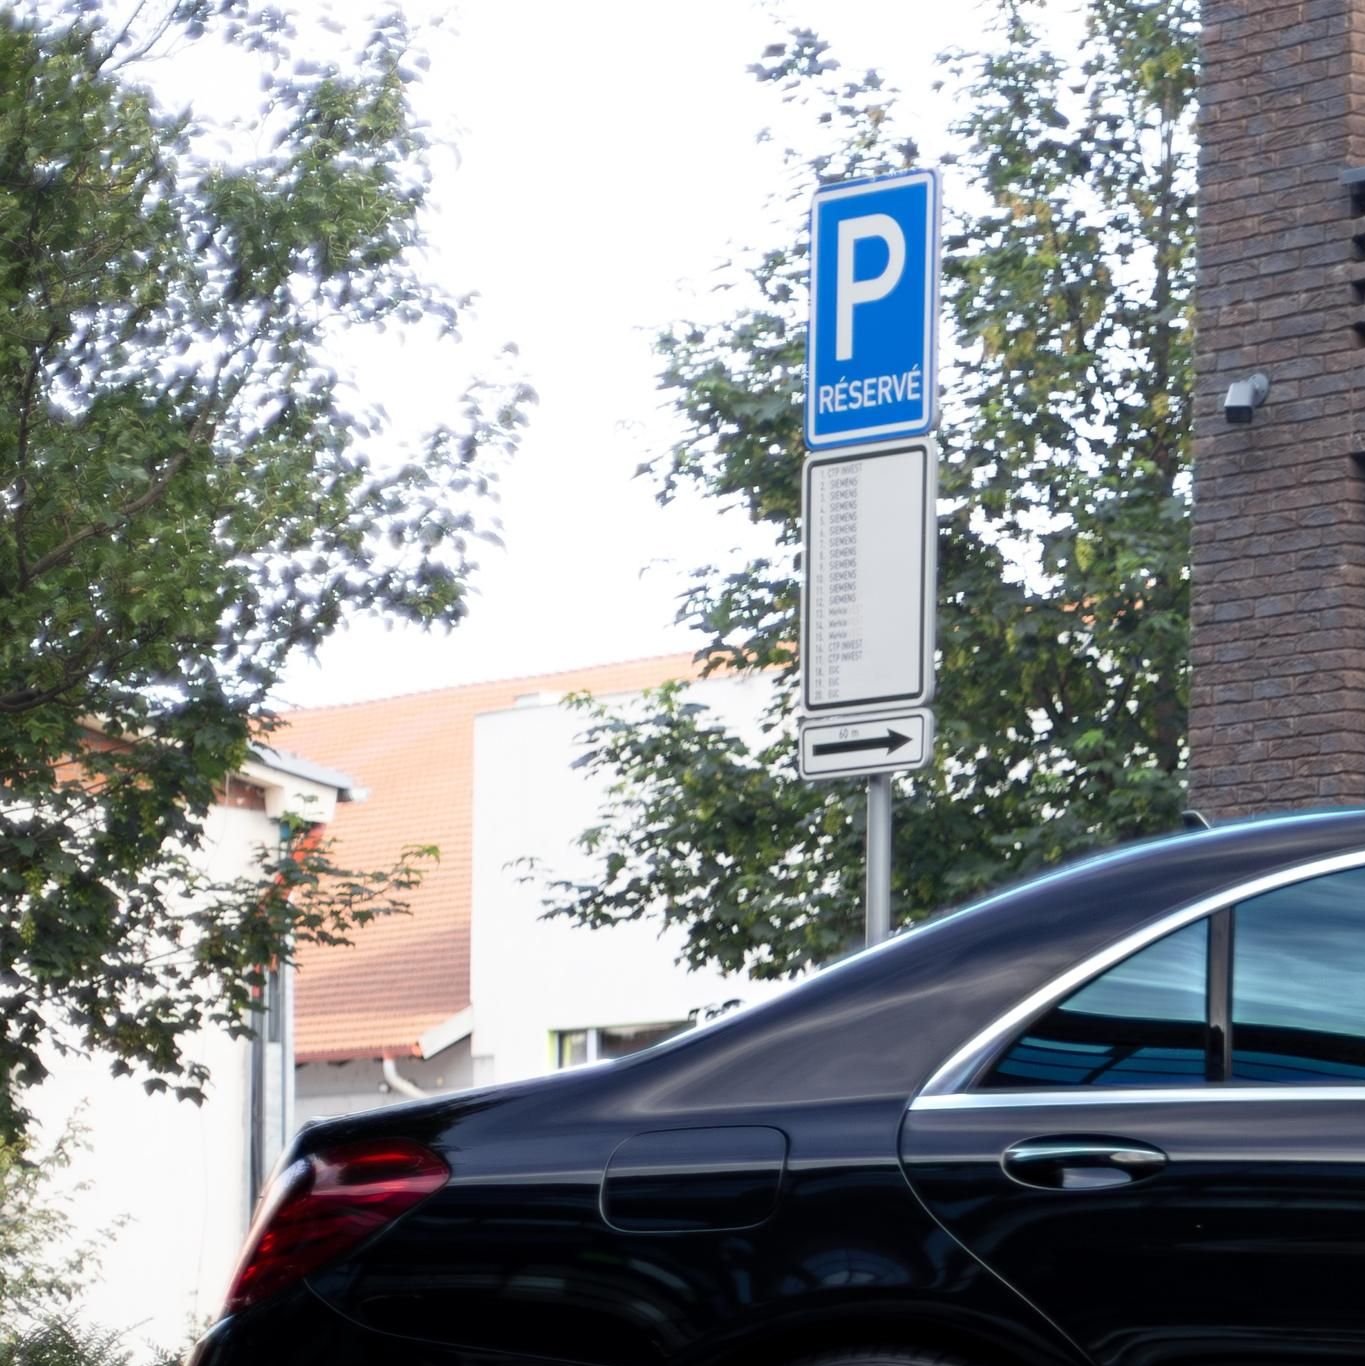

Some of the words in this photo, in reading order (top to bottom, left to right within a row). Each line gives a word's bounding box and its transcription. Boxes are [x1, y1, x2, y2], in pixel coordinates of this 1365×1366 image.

[835, 213, 906, 362] P
[819, 363, 921, 414] RÉSERVÉ
[830, 477, 857, 489] SIEMENS
[830, 489, 857, 501] SIEMENS
[830, 500, 857, 512] SIEMENS
[830, 512, 857, 524] SIEMENS
[829, 523, 857, 536] SIEMENS
[829, 535, 856, 547] SIEMENS
[829, 547, 856, 559] SIEMENS
[829, 558, 856, 571] SIEMENS
[829, 570, 856, 582] SIEMENS
[829, 581, 856, 593] SIEMENS
[829, 593, 856, 605] SIEMENS
